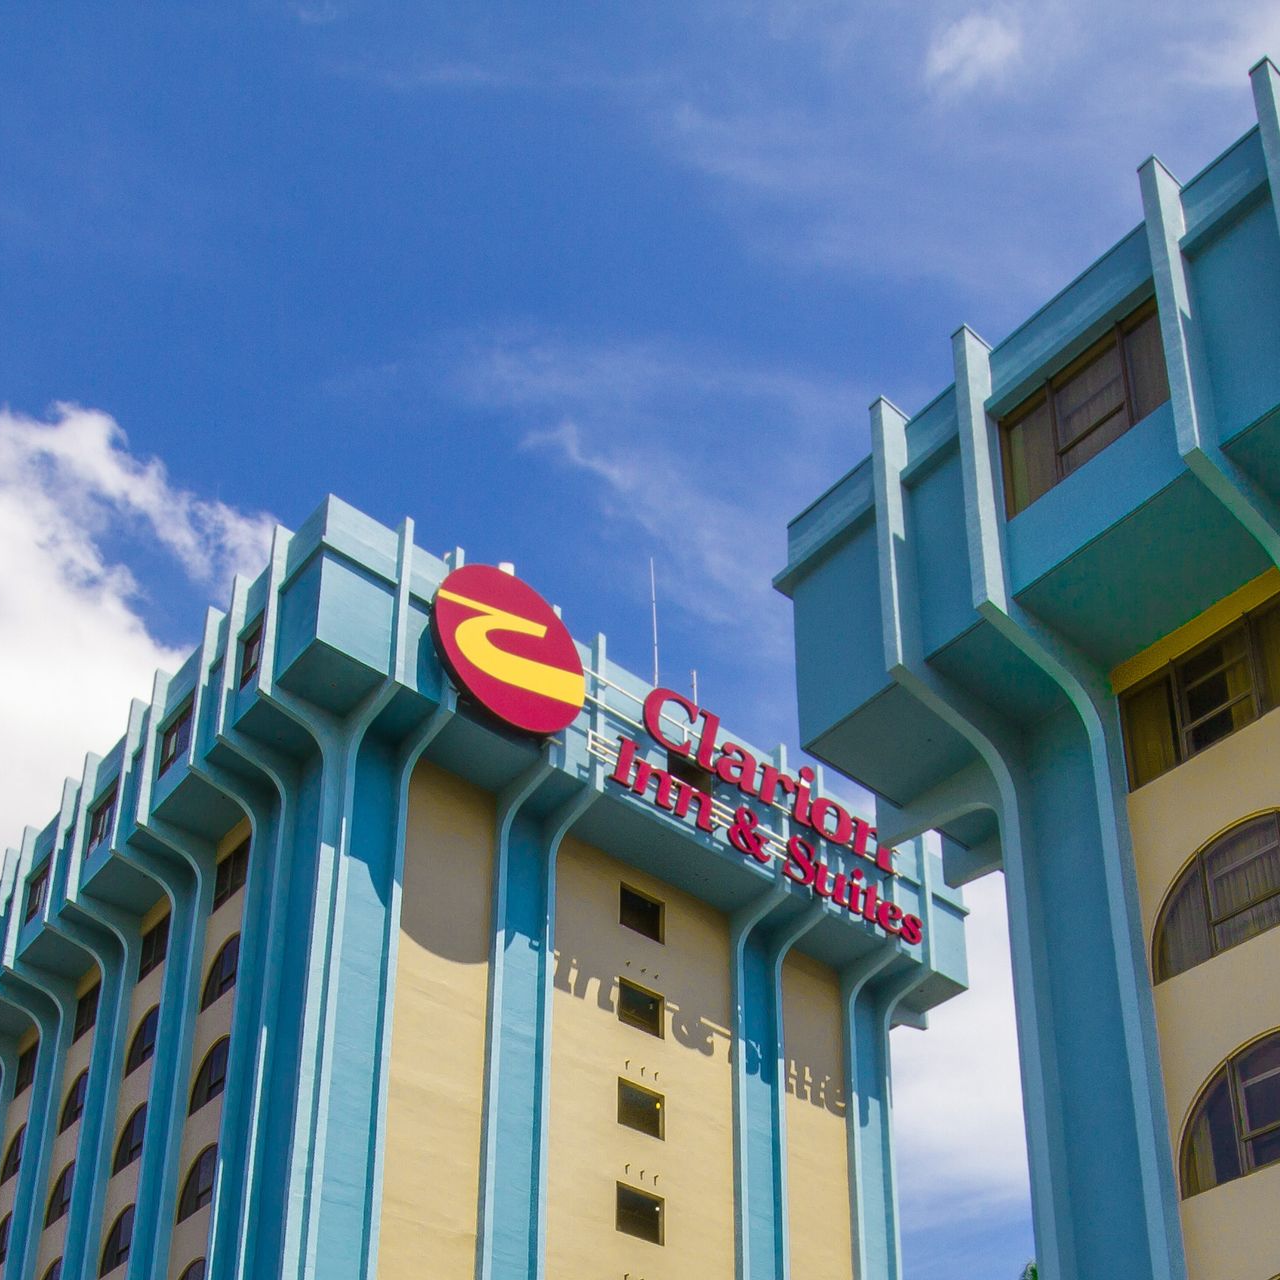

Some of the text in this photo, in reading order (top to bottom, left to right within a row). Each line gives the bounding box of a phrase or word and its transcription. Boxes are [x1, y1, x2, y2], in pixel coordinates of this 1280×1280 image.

[608, 735, 923, 945] Inn & Suites
[643, 687, 895, 874] Clarion
